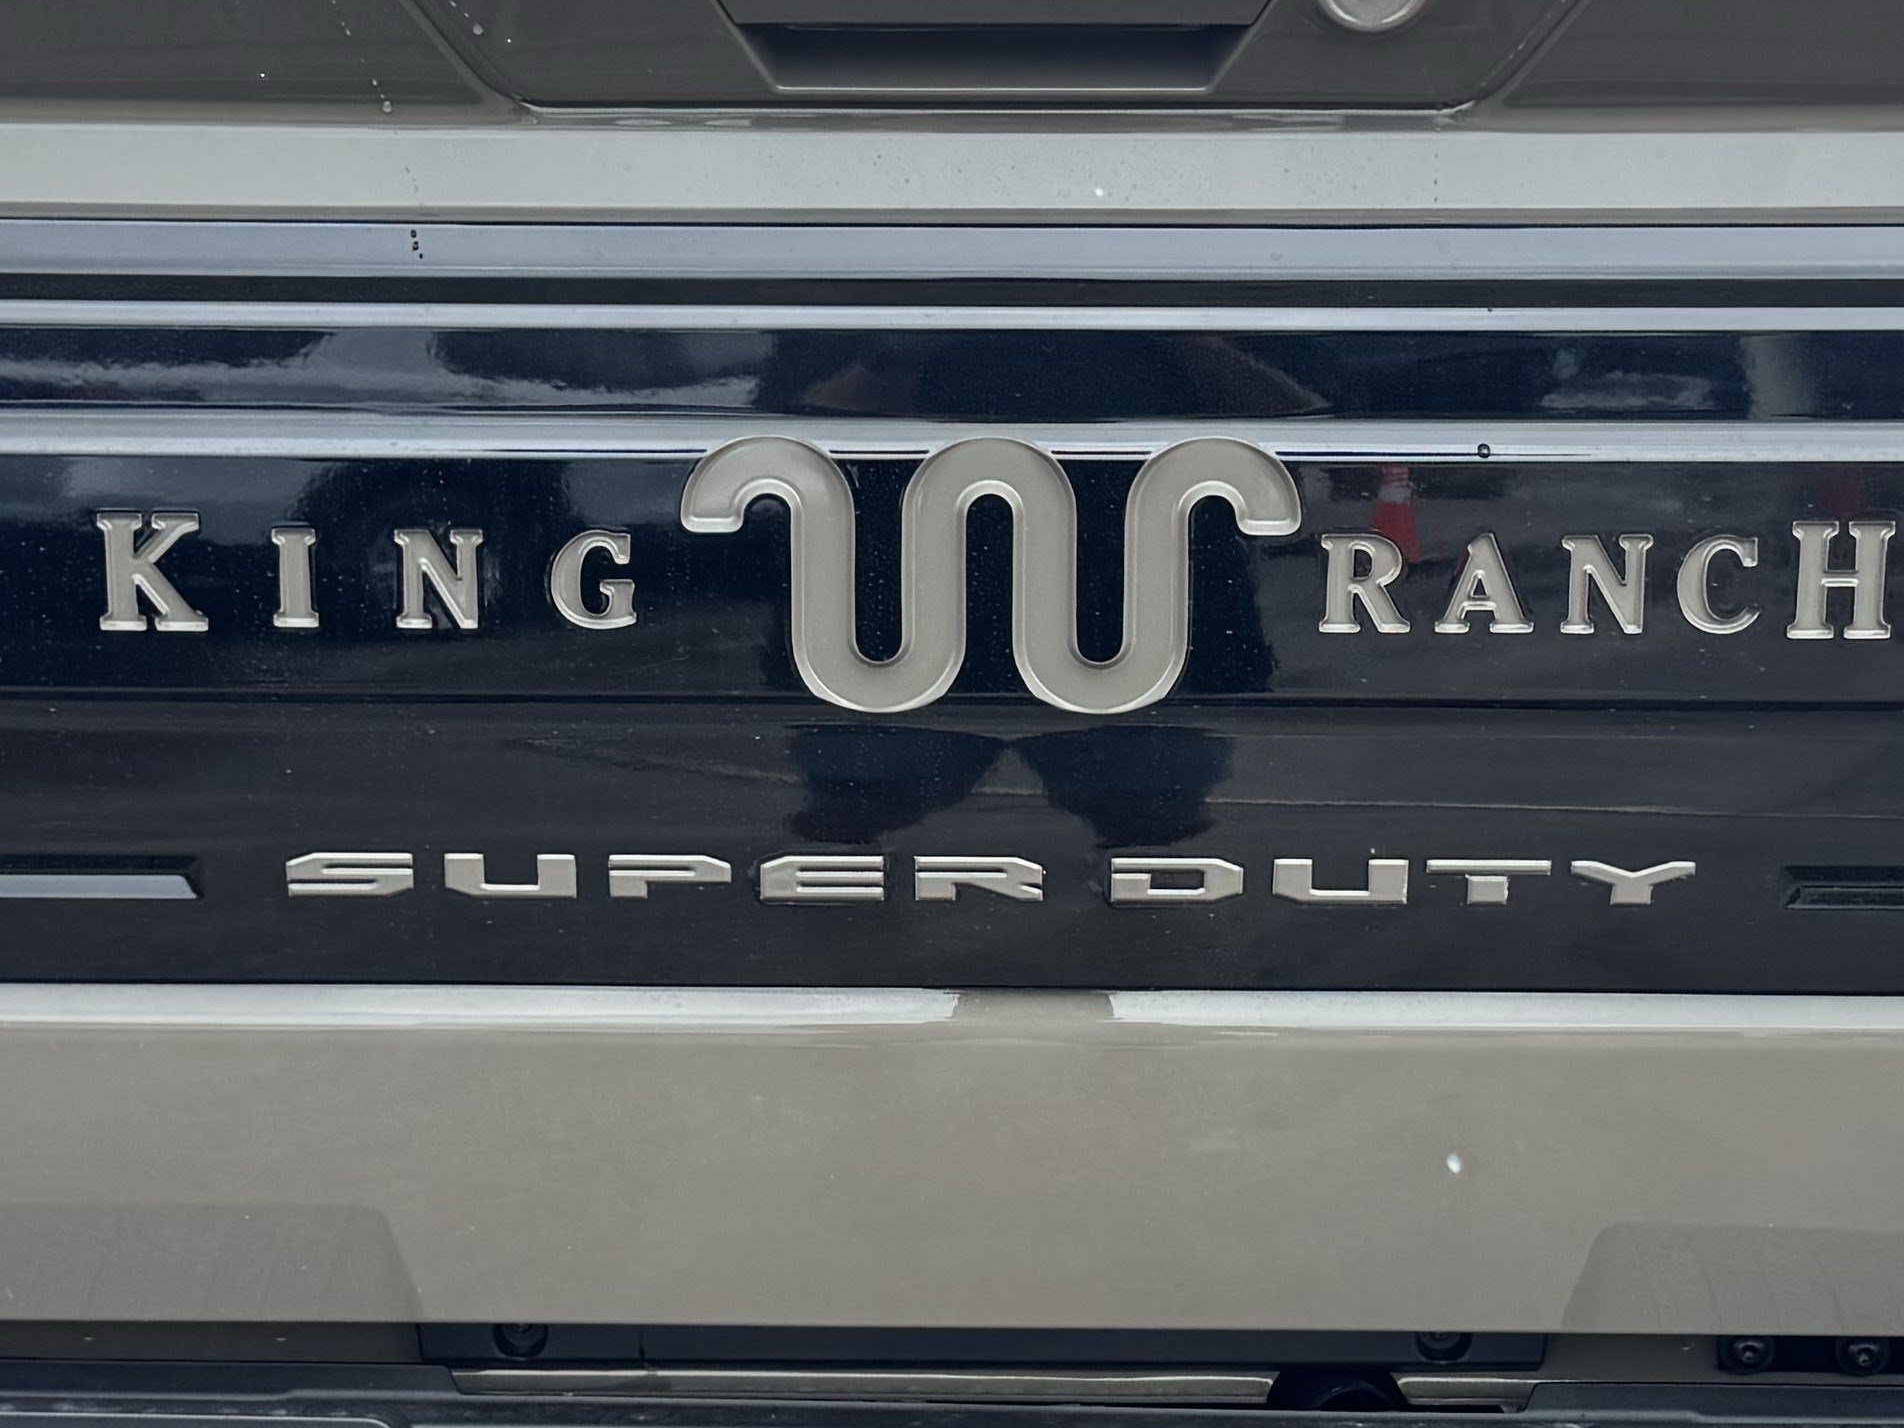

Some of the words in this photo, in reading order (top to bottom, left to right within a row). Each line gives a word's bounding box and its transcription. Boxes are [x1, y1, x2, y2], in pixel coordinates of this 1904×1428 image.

[96, 511, 638, 632] KING
[1317, 520, 1897, 640] RANCH
[285, 851, 1045, 904] SUPER
[1109, 856, 1697, 906] DUTY
